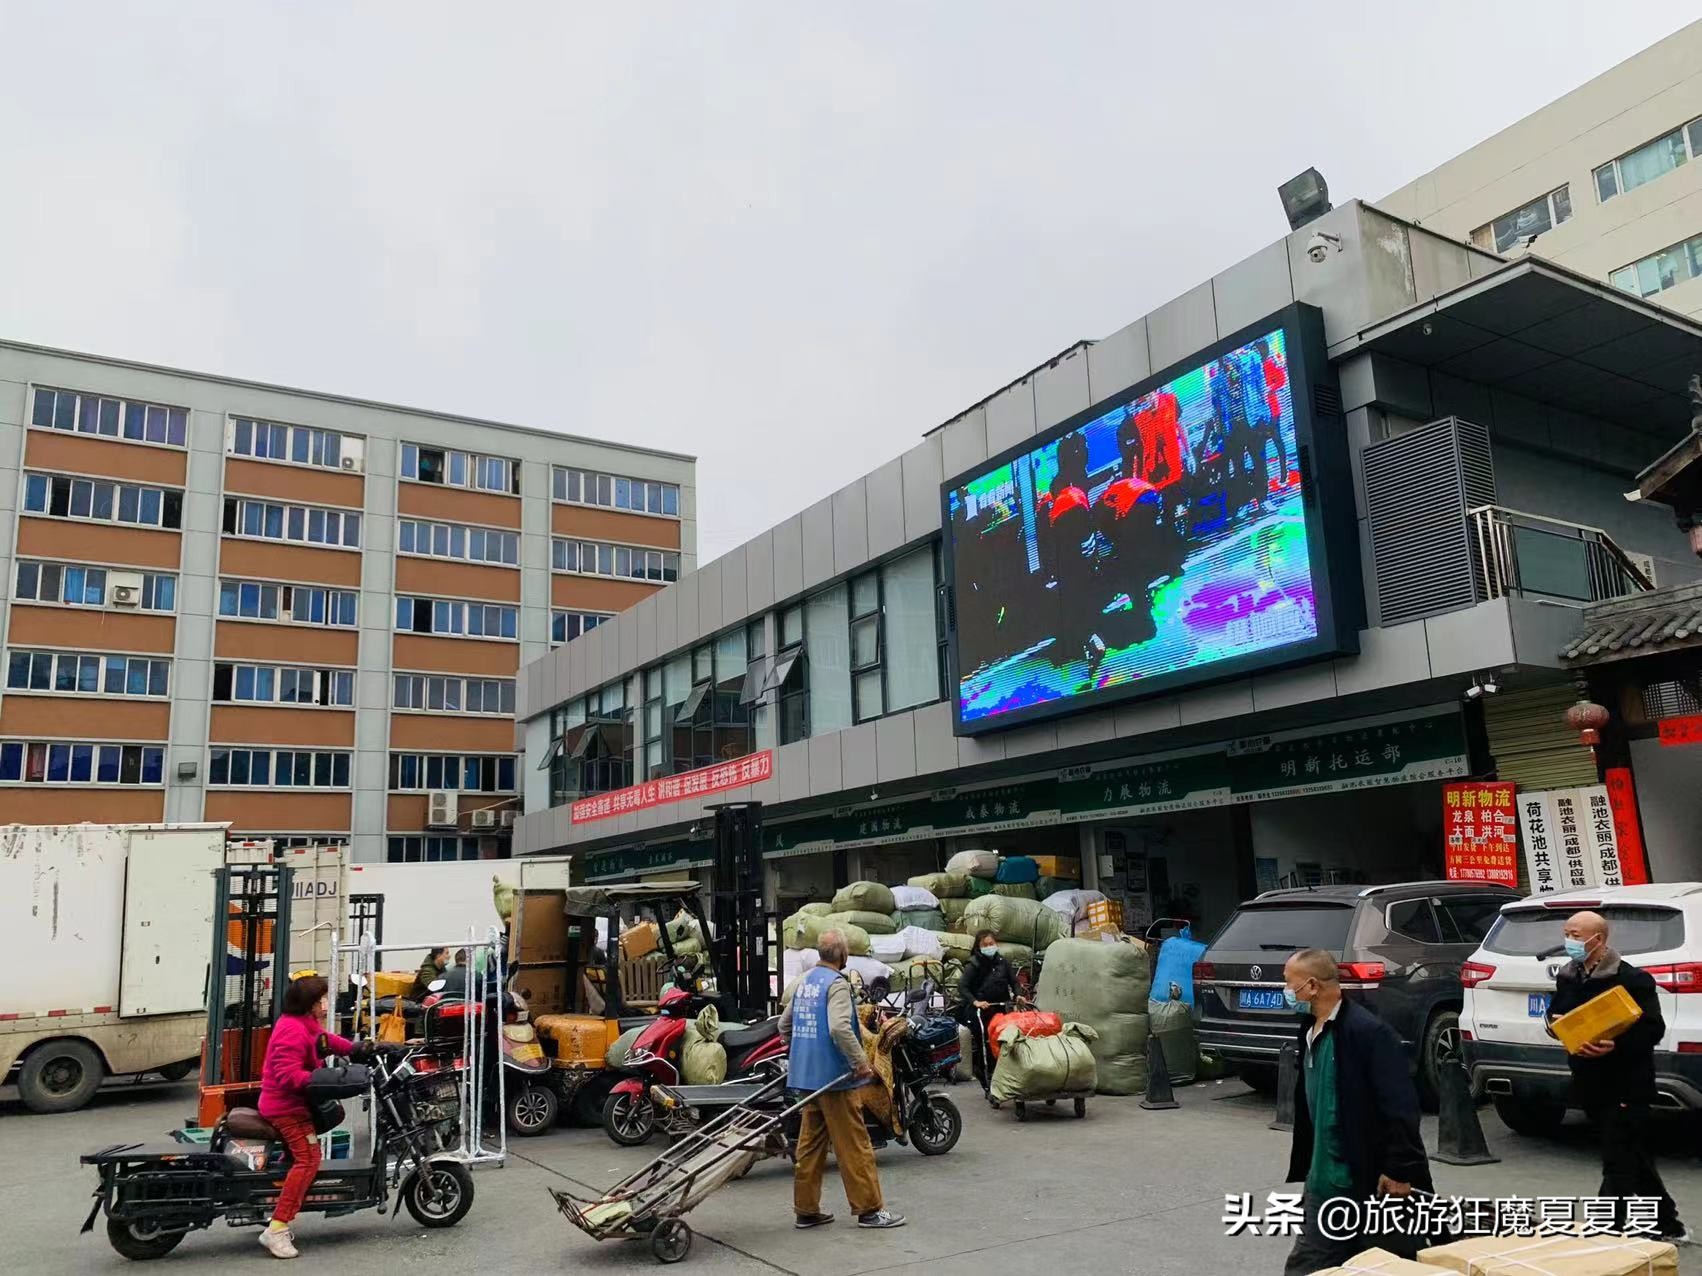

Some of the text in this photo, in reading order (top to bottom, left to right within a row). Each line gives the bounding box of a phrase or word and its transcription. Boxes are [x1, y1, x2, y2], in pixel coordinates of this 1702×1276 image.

[741, 755, 769, 780] 反暴力
[1280, 743, 1401, 776] 明新托运部
[1447, 789, 1511, 808] 明新物流
[1452, 810, 1475, 823] 龙泉
[1453, 826, 1475, 839] 大面
[1481, 826, 1505, 839] 洪河
